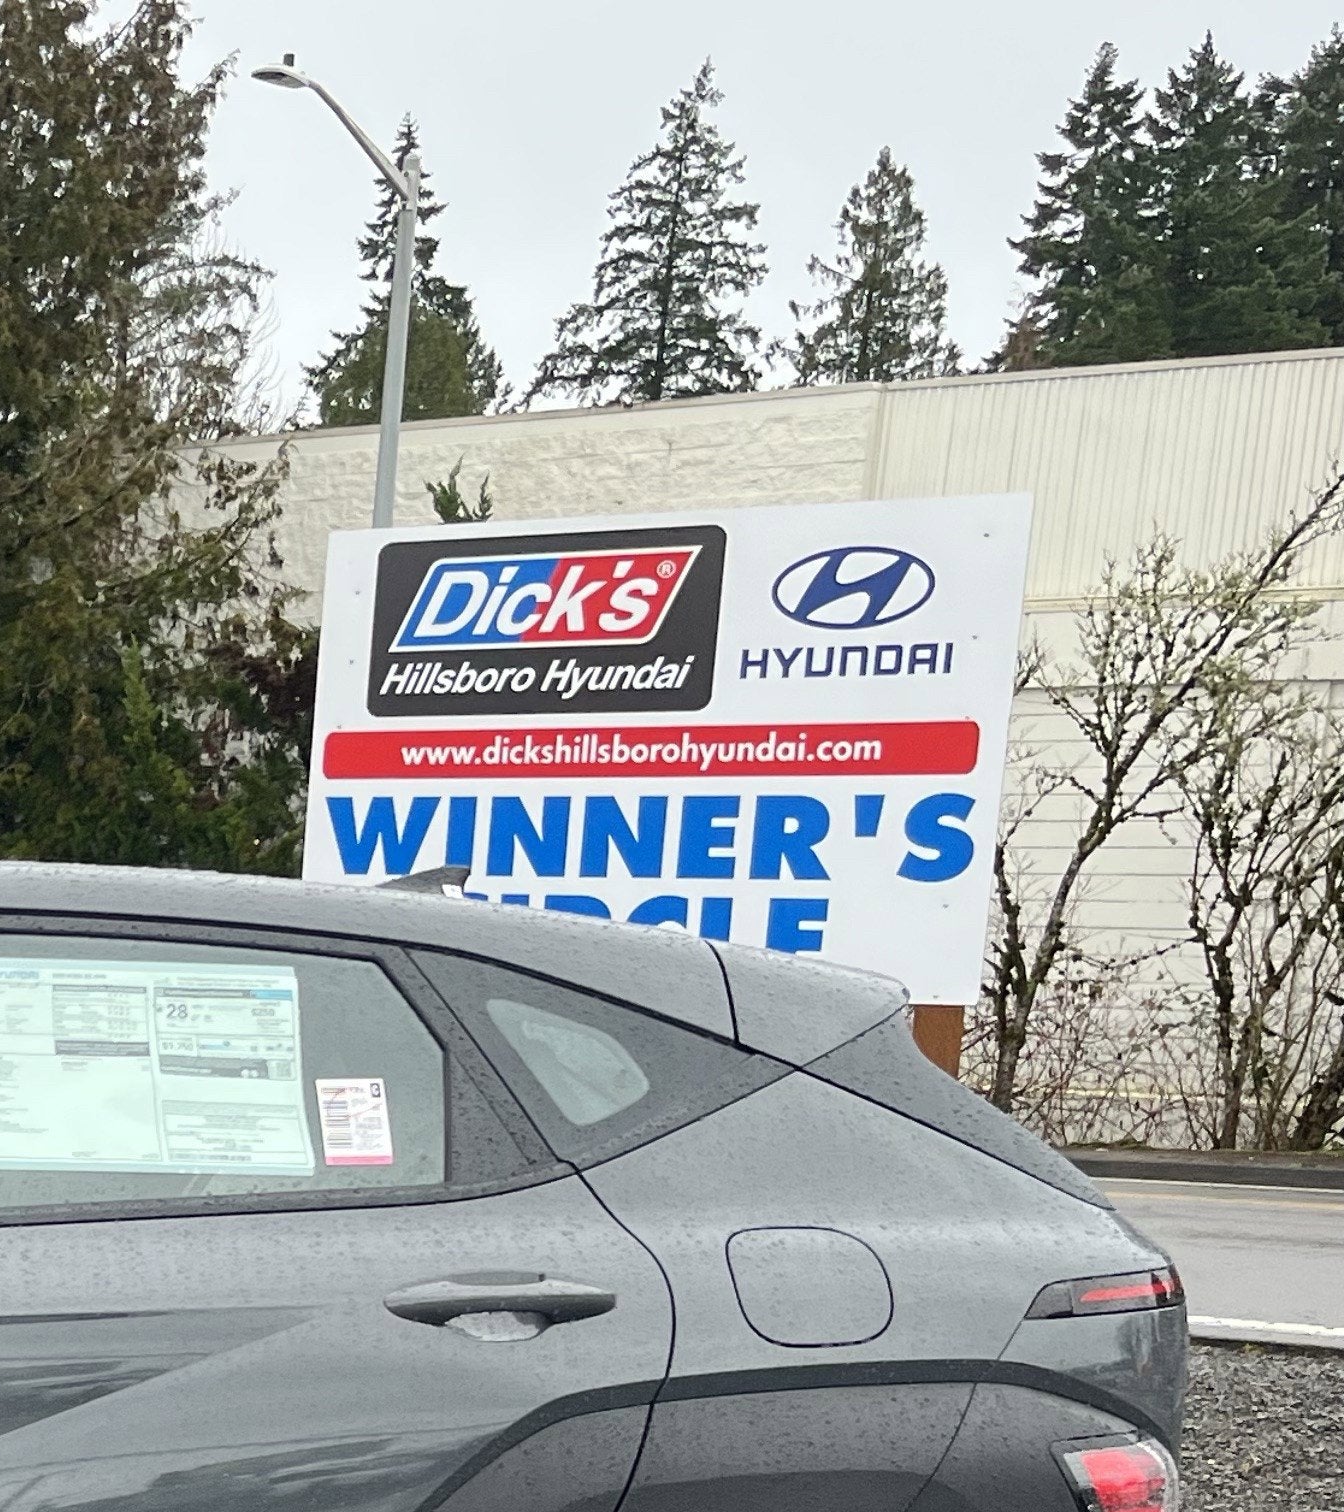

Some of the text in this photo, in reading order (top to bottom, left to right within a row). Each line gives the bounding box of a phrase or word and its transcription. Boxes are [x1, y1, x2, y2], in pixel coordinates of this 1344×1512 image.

[379, 655, 695, 700] Hillsboro Hyundai
[740, 643, 954, 679] HYUNDAI
[400, 731, 882, 772] www.dickshillsborohyundai.com
[324, 793, 977, 883] WINNER'S
[166, 1003, 188, 1019] 28
